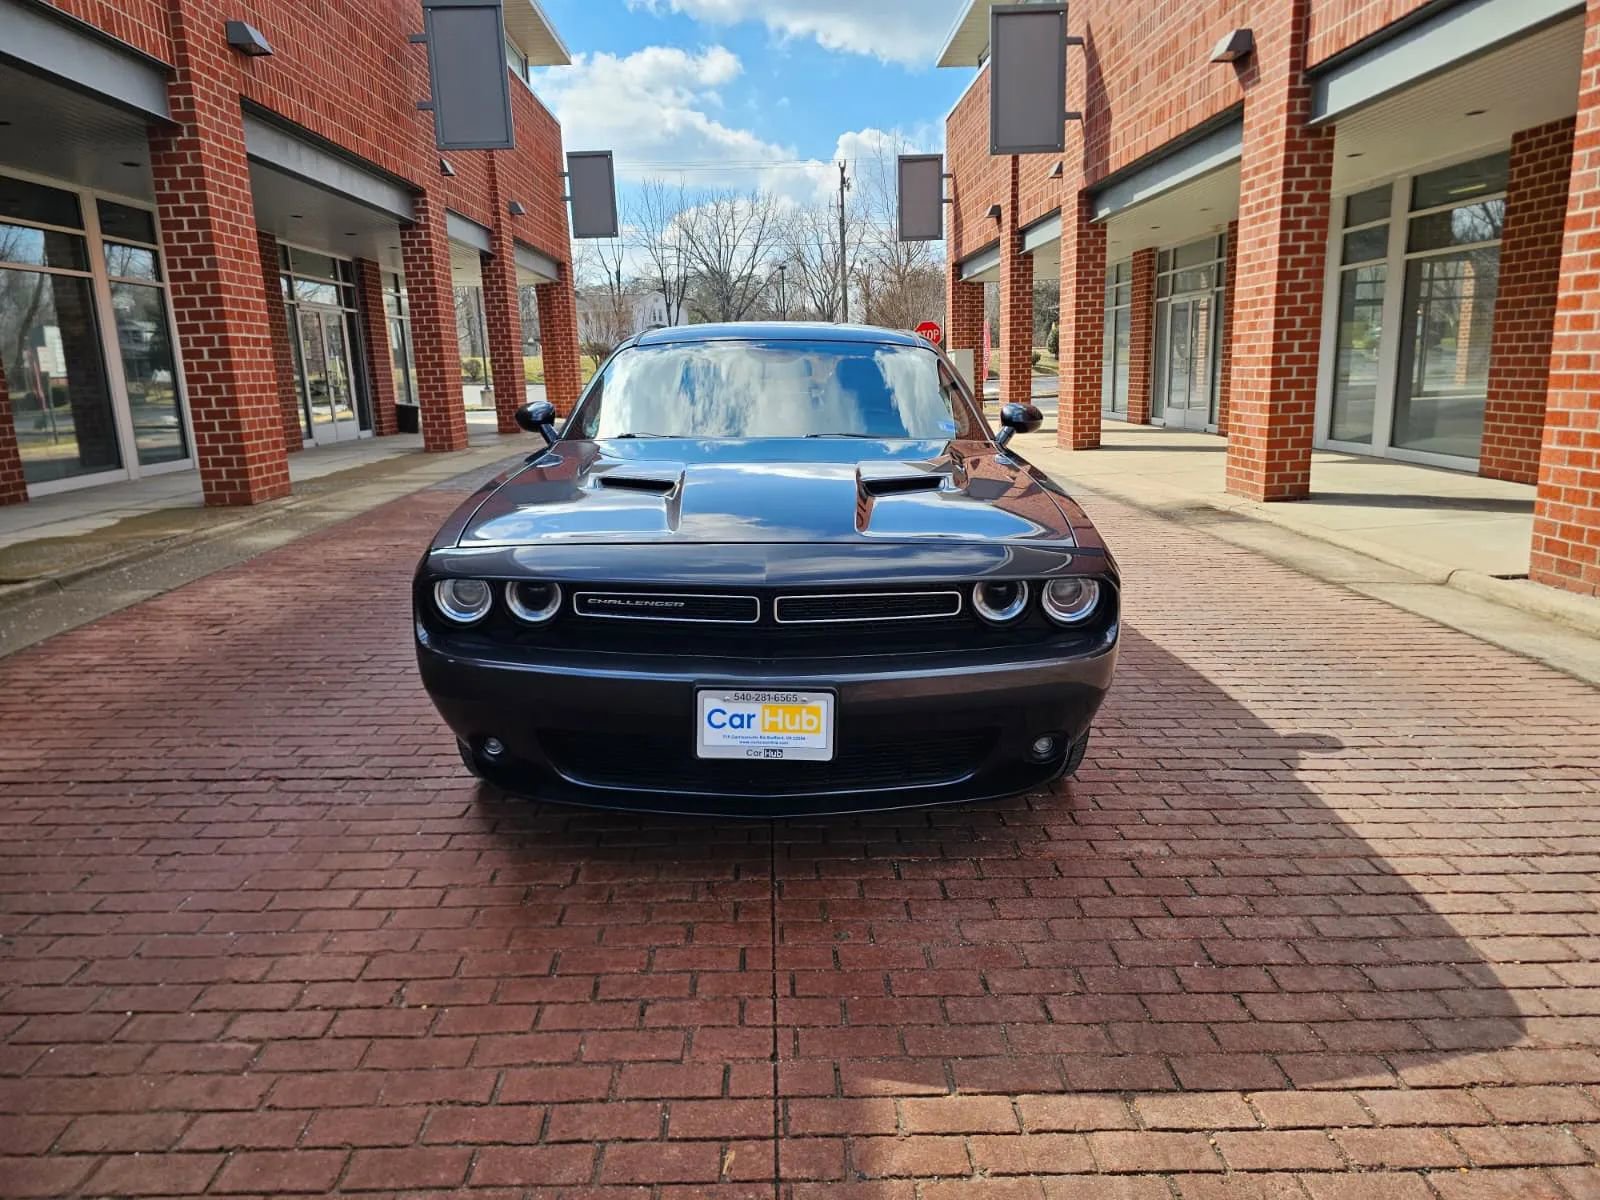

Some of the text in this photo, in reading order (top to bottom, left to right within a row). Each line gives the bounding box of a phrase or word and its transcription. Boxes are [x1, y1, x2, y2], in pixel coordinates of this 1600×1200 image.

[917, 329, 940, 341] TOP
[587, 598, 686, 608] CHALLENGER
[734, 692, 798, 703] 540-281-6565
[707, 708, 818, 730] Car Hub
[746, 749, 783, 758] Car Hub
